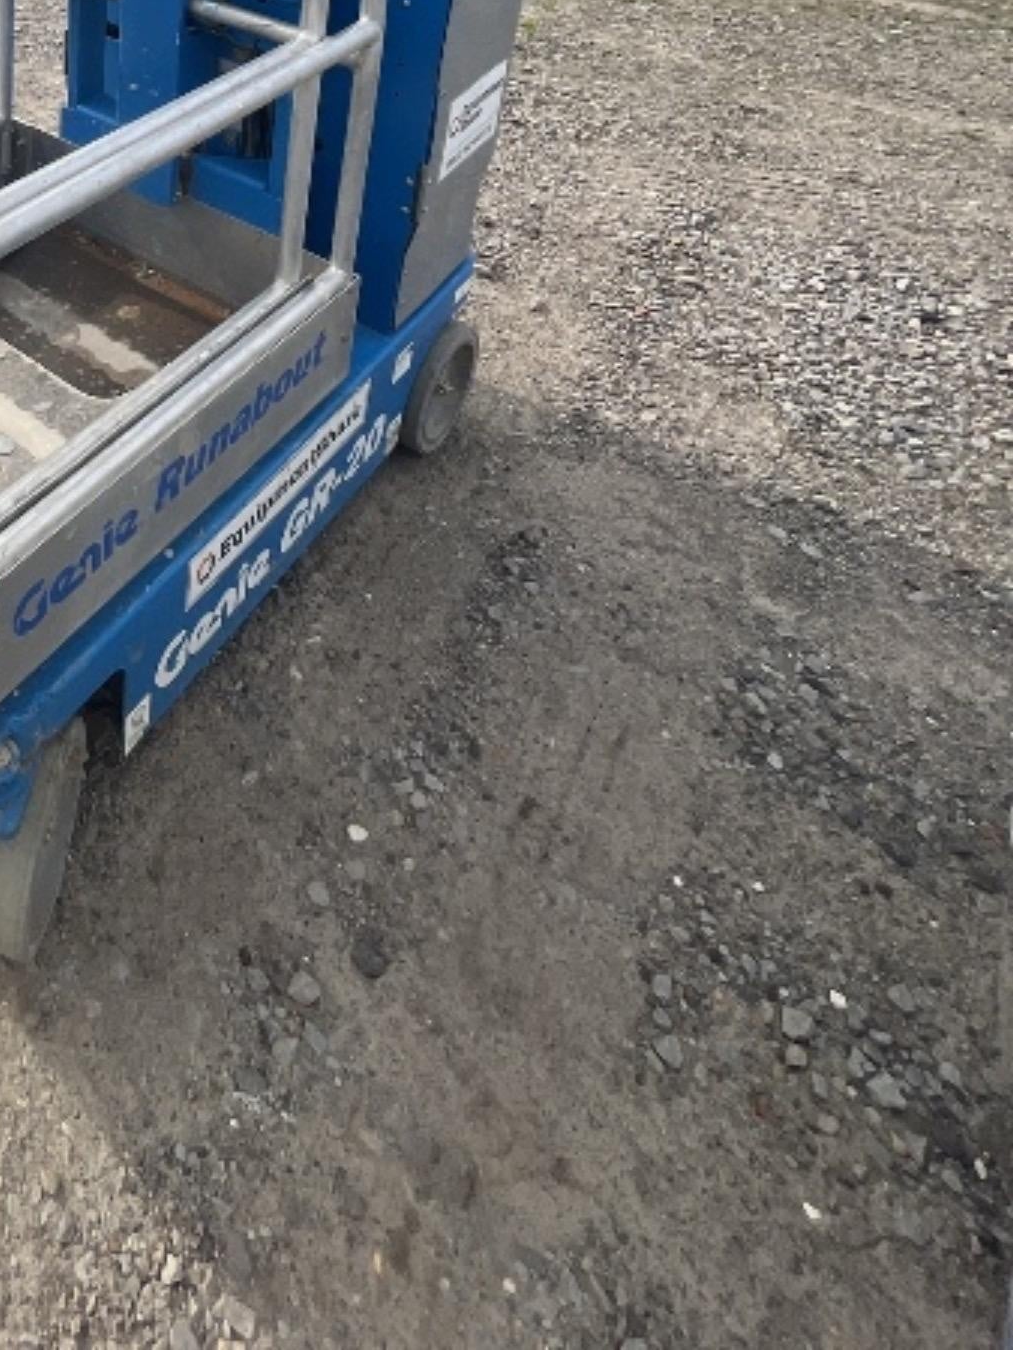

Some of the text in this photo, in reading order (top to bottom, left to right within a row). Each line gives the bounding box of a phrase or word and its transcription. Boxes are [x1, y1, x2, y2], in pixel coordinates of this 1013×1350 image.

[13, 330, 326, 637] Genie Runabout
[154, 549, 270, 688] Genie
